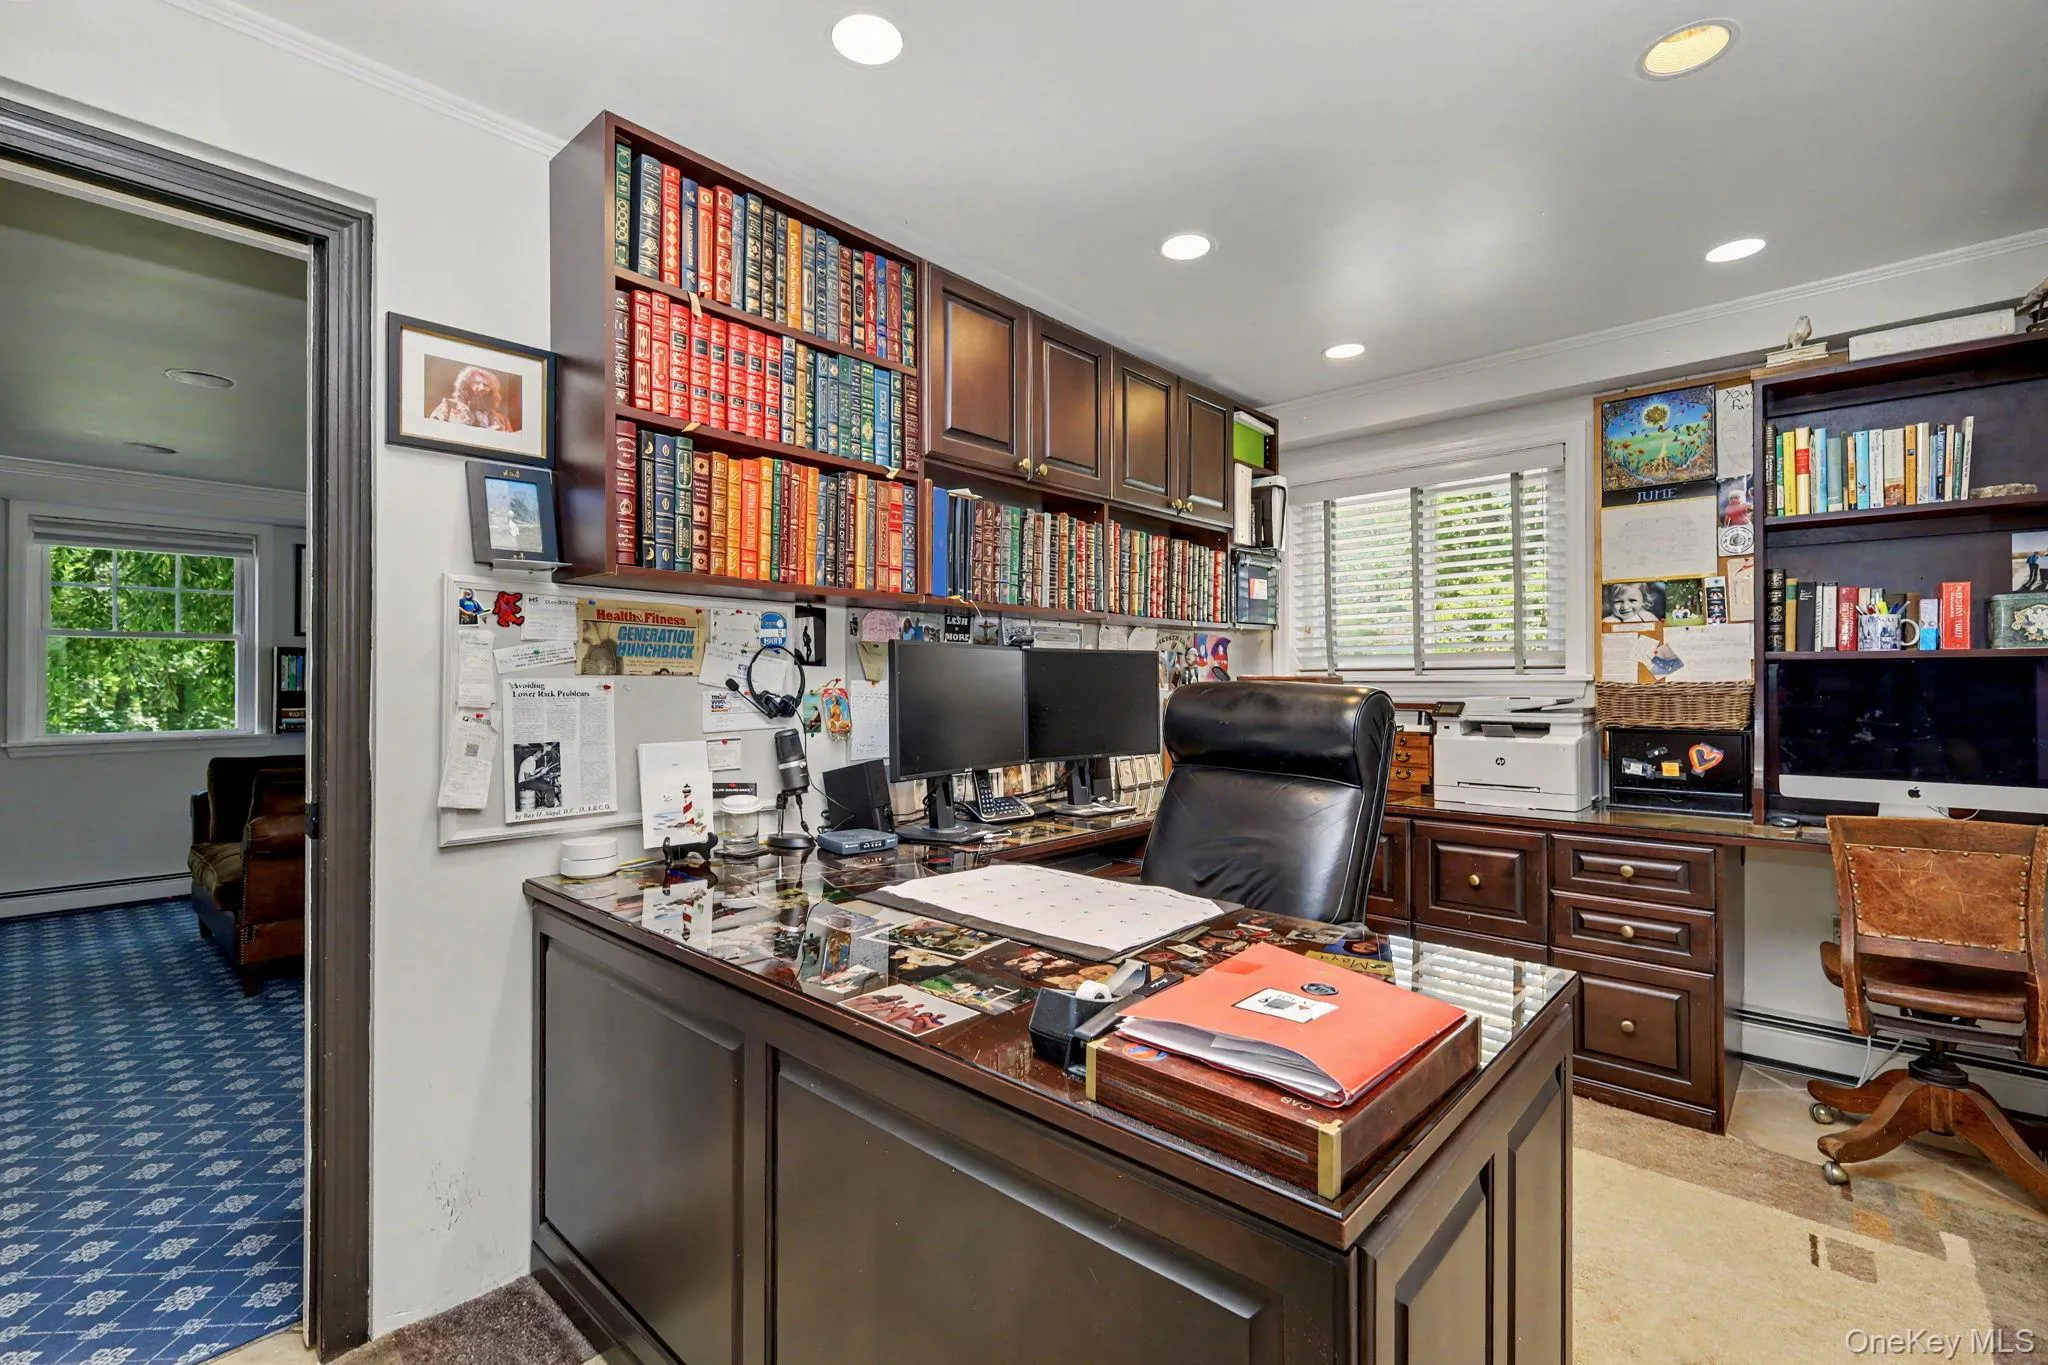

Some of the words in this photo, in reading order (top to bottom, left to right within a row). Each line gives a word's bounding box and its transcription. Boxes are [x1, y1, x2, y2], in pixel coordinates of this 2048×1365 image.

[1636, 487, 1678, 504] JUNE
[596, 609, 637, 622] Health
[644, 612, 686, 626] Fitness
[617, 626, 695, 645] GENERATION
[616, 642, 695, 659] HUNCHBACK
[512, 690, 536, 698] Lower
[557, 689, 590, 697] Problems
[513, 681, 546, 691] Avoiding
[1320, 953, 1370, 970] Maya
[1280, 1096, 1312, 1110] CAB
